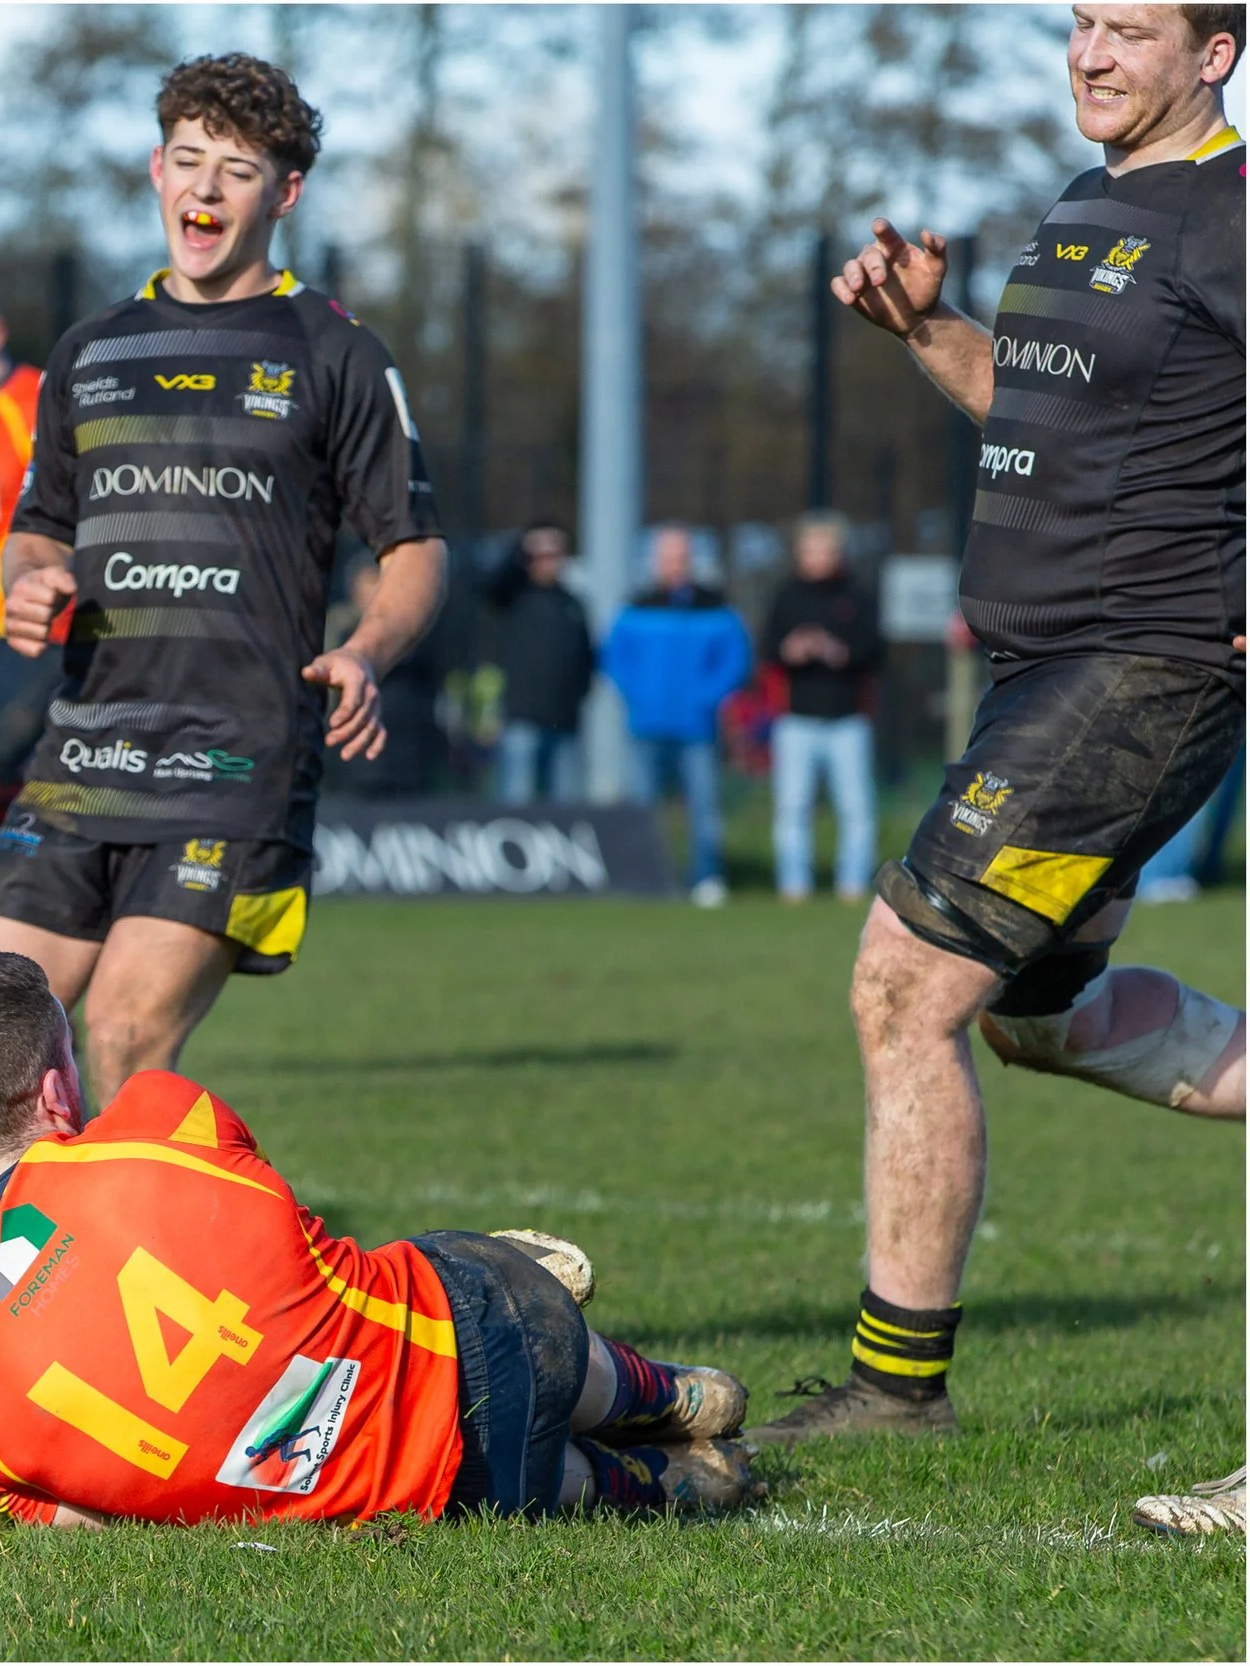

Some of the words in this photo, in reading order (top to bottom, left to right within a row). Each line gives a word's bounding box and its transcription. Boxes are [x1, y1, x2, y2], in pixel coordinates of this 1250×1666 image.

[992, 336, 1096, 383] OMINION
[89, 464, 274, 504] DOMINION
[105, 552, 240, 597] Compra
[60, 738, 148, 773] Qualis
[9, 1233, 76, 1318] FOREMAN
[30, 1255, 80, 1318] HOMES
[316, 1426, 334, 1460] Sports
[327, 1394, 347, 1424] Injury
[341, 1363, 356, 1392] Clinic
